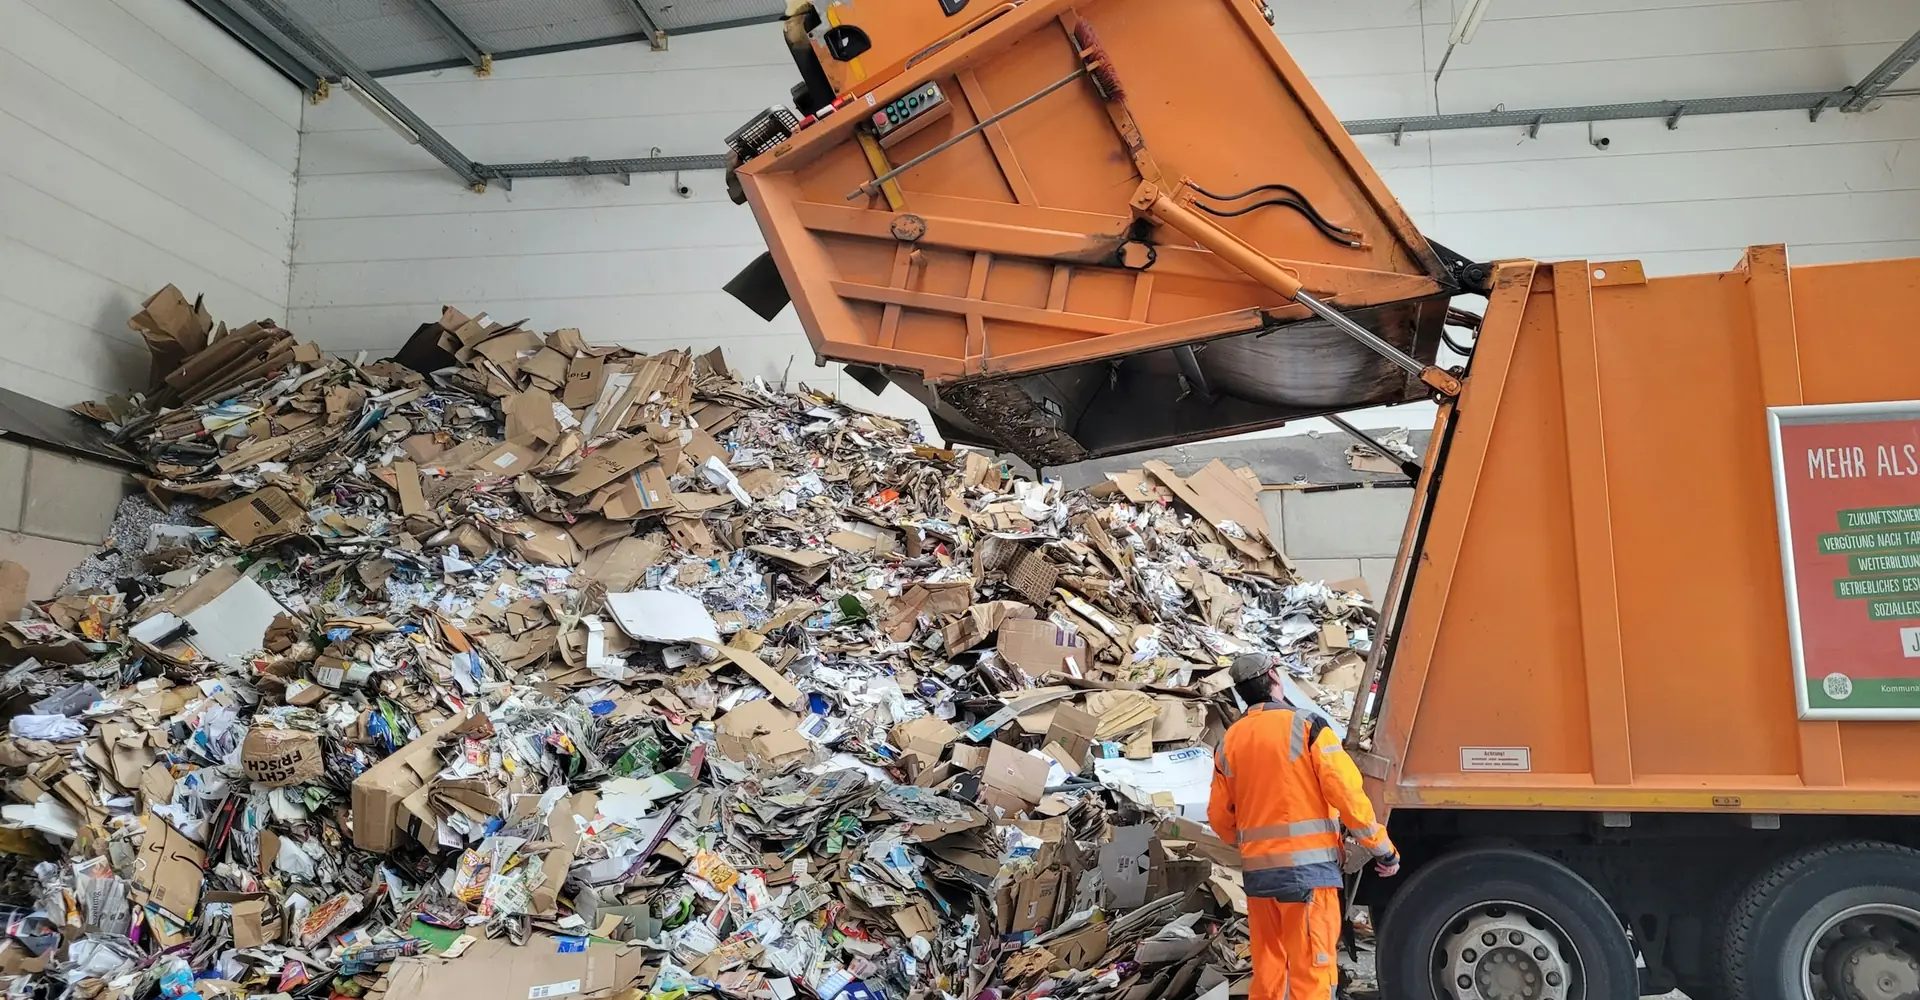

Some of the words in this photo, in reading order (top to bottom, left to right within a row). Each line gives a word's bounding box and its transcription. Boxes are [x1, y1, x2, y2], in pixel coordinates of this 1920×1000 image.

[1807, 446, 1867, 480] MEHR
[1877, 443, 1918, 477] ALS
[1823, 534, 1875, 551] VERGÜTUNG
[1877, 532, 1902, 547] NACH
[1840, 578, 1900, 596] BETRIEBLICHES
[1873, 601, 1920, 617] SOZIALLEIS
[1911, 631, 1920, 652] J
[1880, 684, 1920, 693] Kommuna
[244, 749, 303, 772] FRISCH.
[257, 766, 296, 782] ECHT
